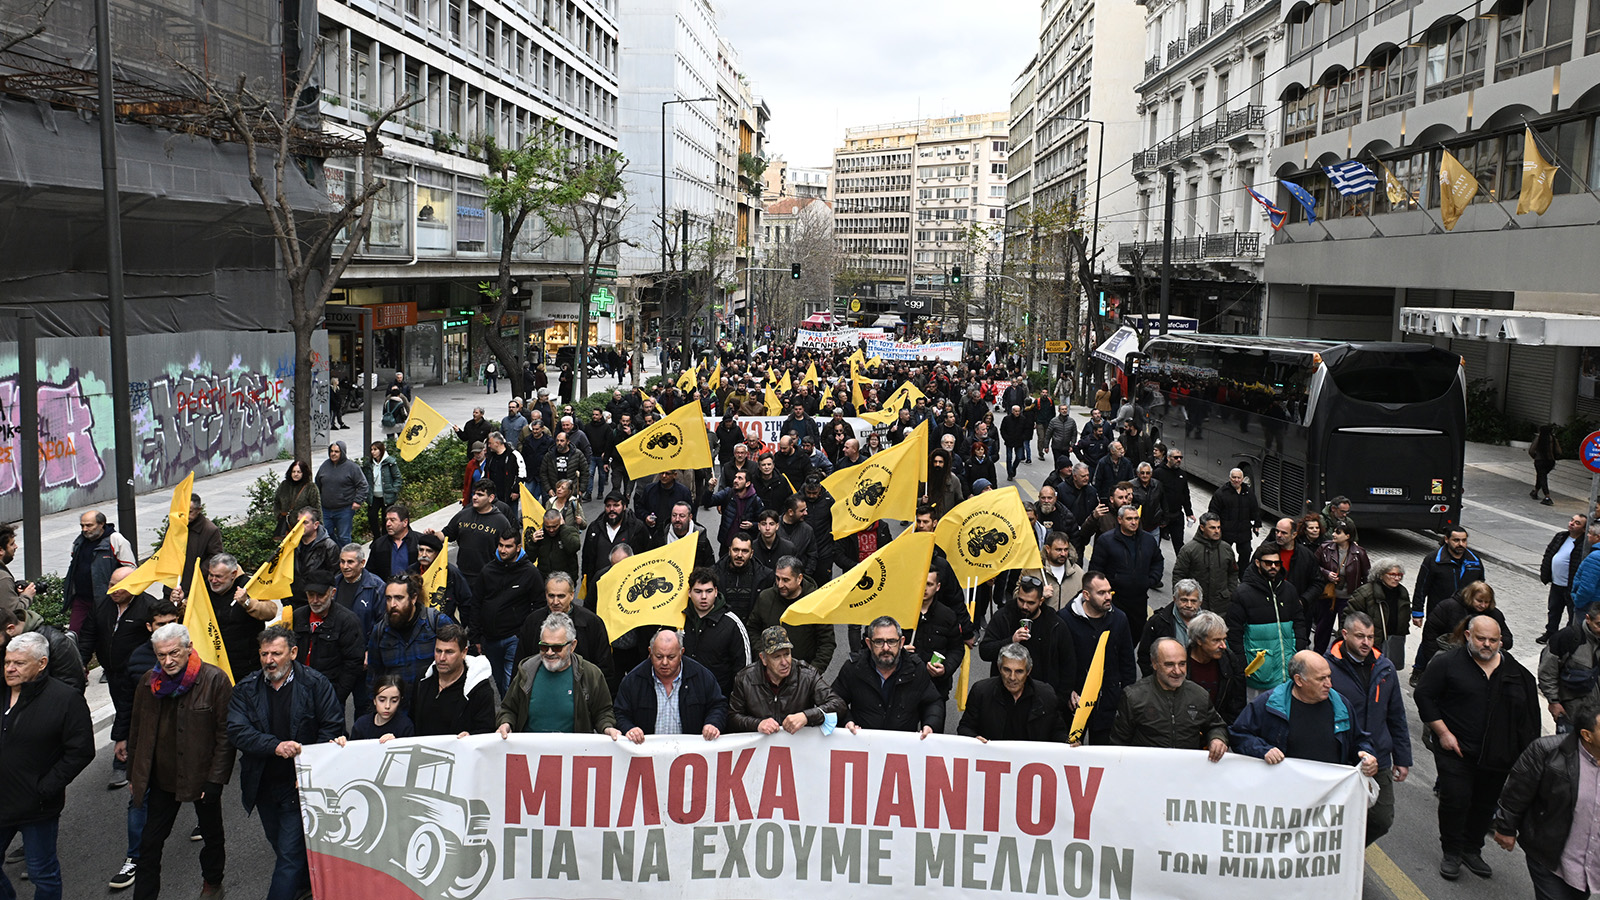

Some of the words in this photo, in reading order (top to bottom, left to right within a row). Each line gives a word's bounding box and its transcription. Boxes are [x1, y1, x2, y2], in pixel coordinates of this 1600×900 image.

[802, 340, 851, 349] ΜΑΓΝΗΣΙΑΣ
[808, 335, 838, 343] ΑΛΙΕΙΣ
[882, 352, 916, 360] ΜΑΓΝΗΣΙΑ
[458, 522, 497, 535] SWOOSH
[504, 745, 800, 828] ΜΠΛΟΚΑ
[828, 749, 1105, 841] ΠΑΝΤΟΥ
[1166, 798, 1344, 829] ΠΑΝΕΛΛΑΔΙΚΗ
[1222, 828, 1343, 854] ΕΠΙΤΡΟΠΗ
[502, 826, 580, 882] ΓΙΑ
[601, 828, 670, 882] ΝΑ
[691, 821, 893, 886] ΕΧΟΥΜΕ
[914, 831, 1135, 900] ΜΕΛΛΟΝ
[1158, 850, 1208, 875] ΤΩΝ
[1219, 853, 1341, 879] ΜΠΛΟΚΩΝ
